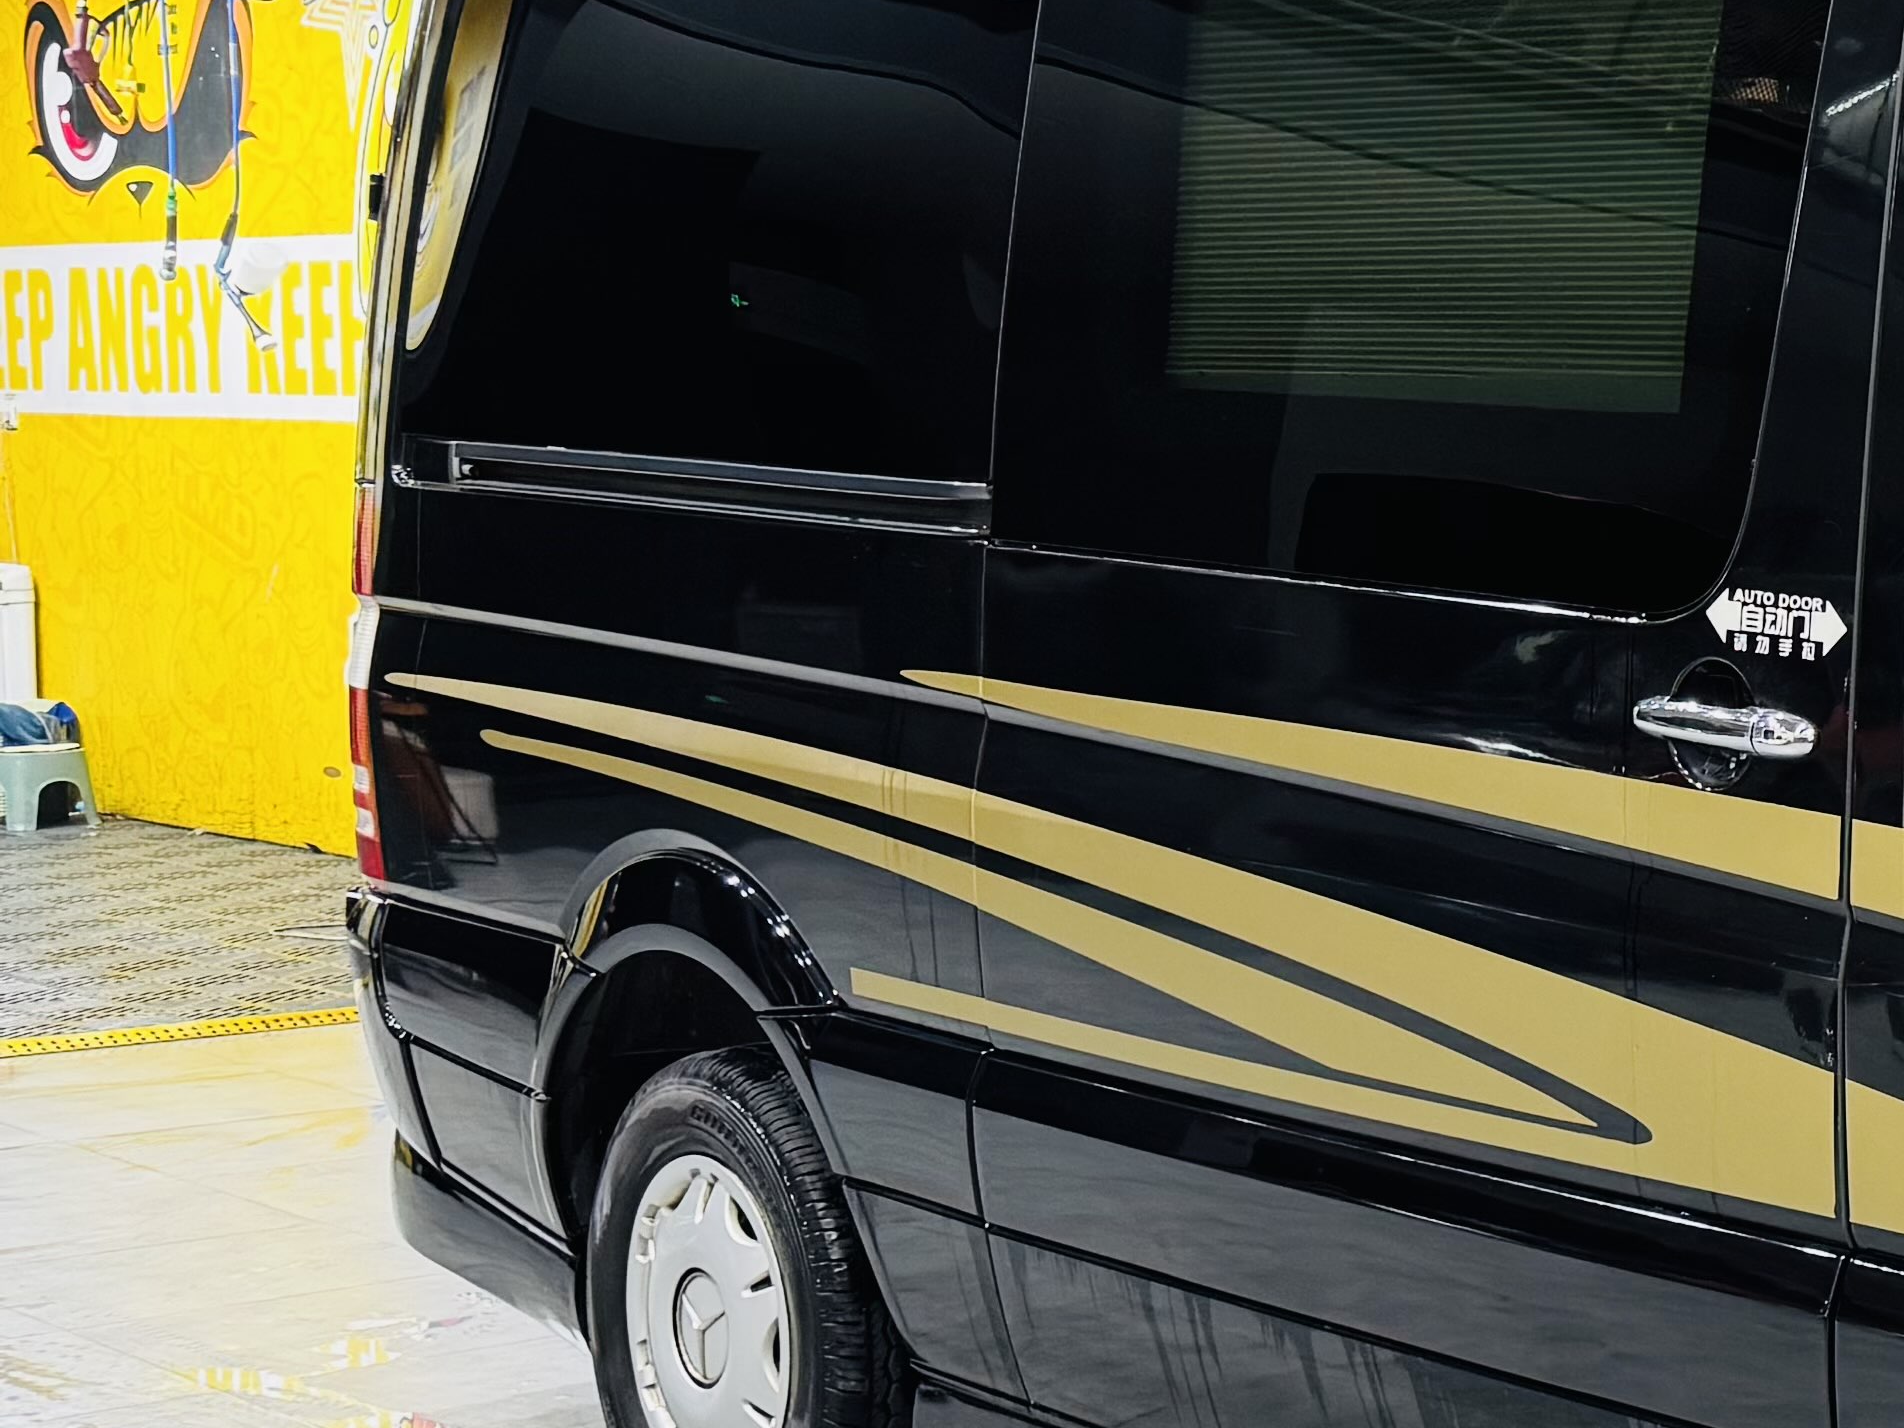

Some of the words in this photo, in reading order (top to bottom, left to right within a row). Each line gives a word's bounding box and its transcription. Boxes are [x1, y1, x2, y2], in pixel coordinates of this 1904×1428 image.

[0, 267, 54, 392] EP
[68, 263, 223, 395] ANGRY
[1733, 587, 1775, 606] AUTO
[1778, 593, 1824, 613] DOOR
[1741, 603, 1810, 640] 自动门
